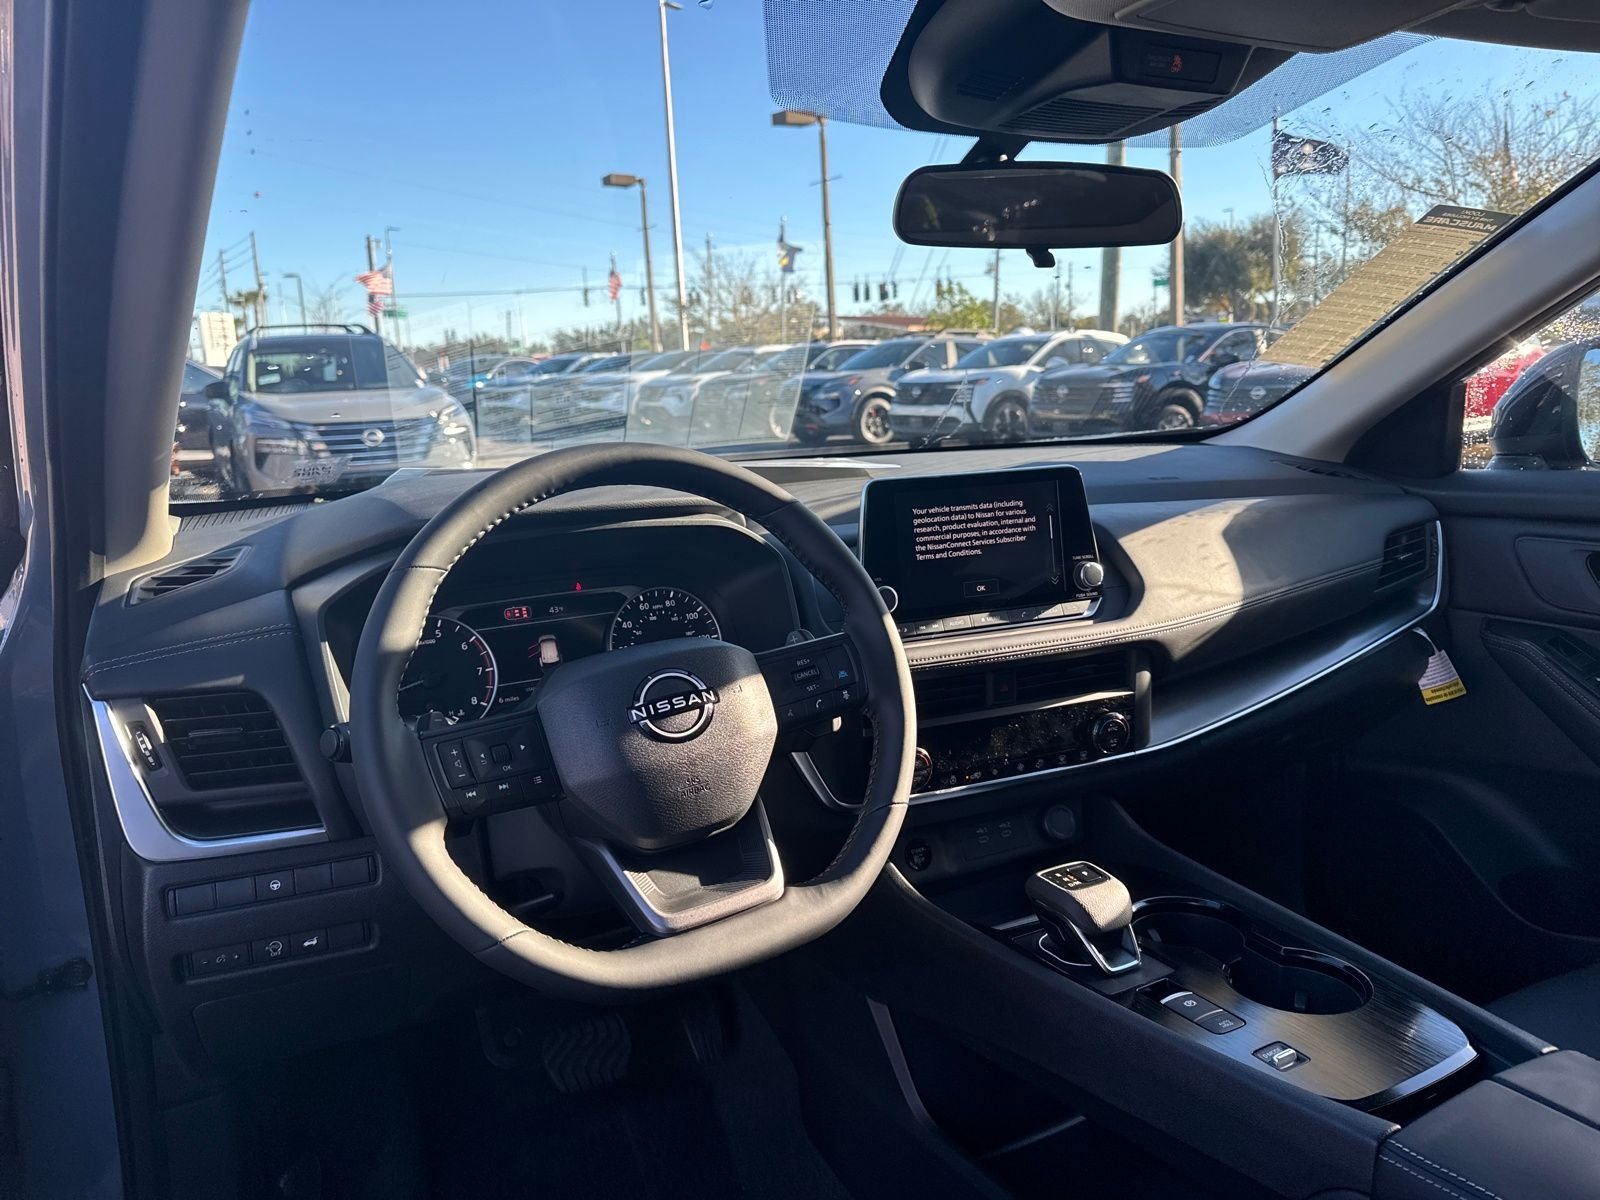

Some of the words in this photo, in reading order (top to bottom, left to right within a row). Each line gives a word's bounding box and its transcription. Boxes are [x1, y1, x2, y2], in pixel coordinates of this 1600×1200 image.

[928, 506, 950, 514] vehicle
[993, 500, 1023, 508] (including
[912, 516, 950, 526] geolocation
[950, 513, 967, 521] data)
[975, 511, 995, 519] Nissan
[913, 525, 942, 534] research,
[942, 523, 967, 532] product
[966, 520, 1000, 529] evaluation,
[1000, 516, 1024, 525] internal
[1024, 515, 1036, 523] and
[915, 533, 952, 542] commercial
[952, 530, 981, 540] purposes,
[988, 527, 1022, 536] accordance
[1022, 524, 1036, 532] with
[915, 544, 926, 552] the
[927, 540, 971, 551] NissanConnect
[971, 538, 996, 546] Services
[995, 535, 1027, 544] Subscriber
[915, 553, 935, 561] Terms
[935, 551, 947, 559] and
[947, 549, 982, 558] Conditions.
[639, 602, 650, 610] 60
[665, 599, 676, 607] 80
[685, 612, 699, 620] 100
[621, 620, 633, 629] 40
[435, 629, 442, 638] 5
[461, 642, 468, 650] 6
[477, 667, 483, 675] 7
[471, 697, 478, 705] 8
[630, 690, 716, 721] NISSAN
